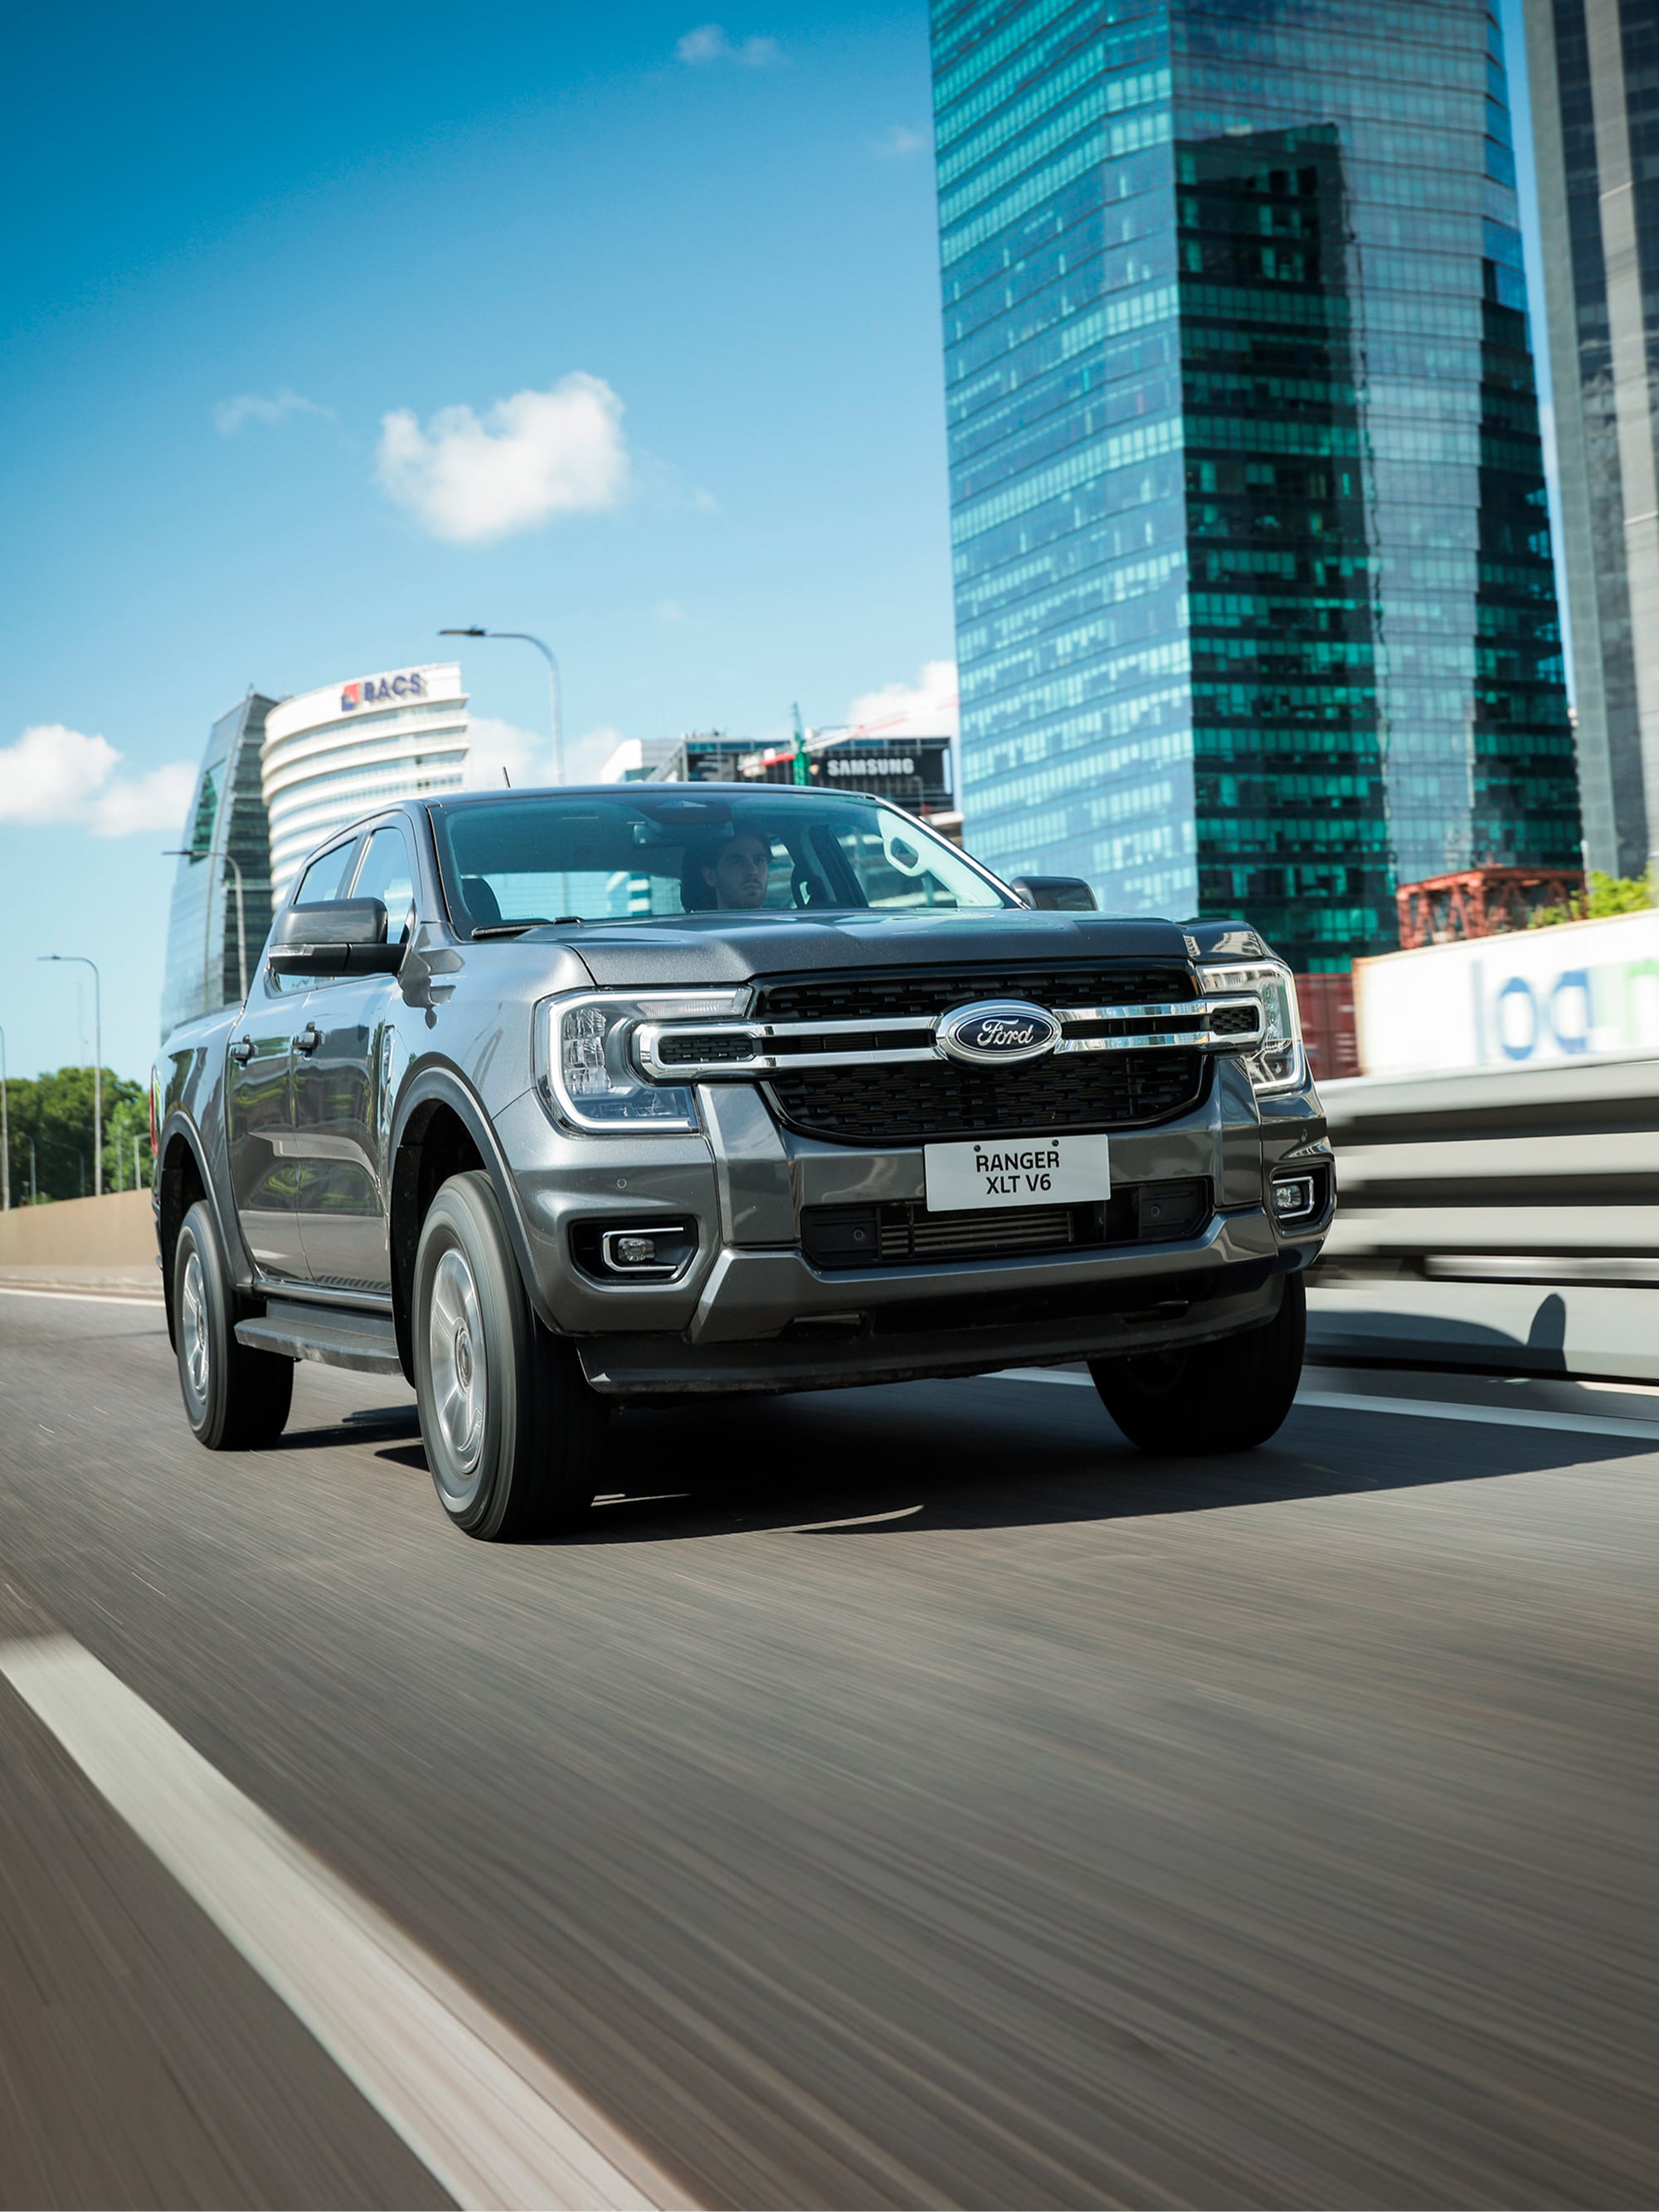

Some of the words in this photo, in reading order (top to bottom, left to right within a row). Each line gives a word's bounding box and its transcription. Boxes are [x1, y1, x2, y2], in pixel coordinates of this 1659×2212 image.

[364, 672, 421, 702] BACS
[827, 757, 914, 776] SAMSUNG
[977, 1018, 1034, 1047] Ford
[975, 1150, 1060, 1173] RANGER
[985, 1175, 1021, 1194] XLT
[1025, 1173, 1052, 1192] V6
